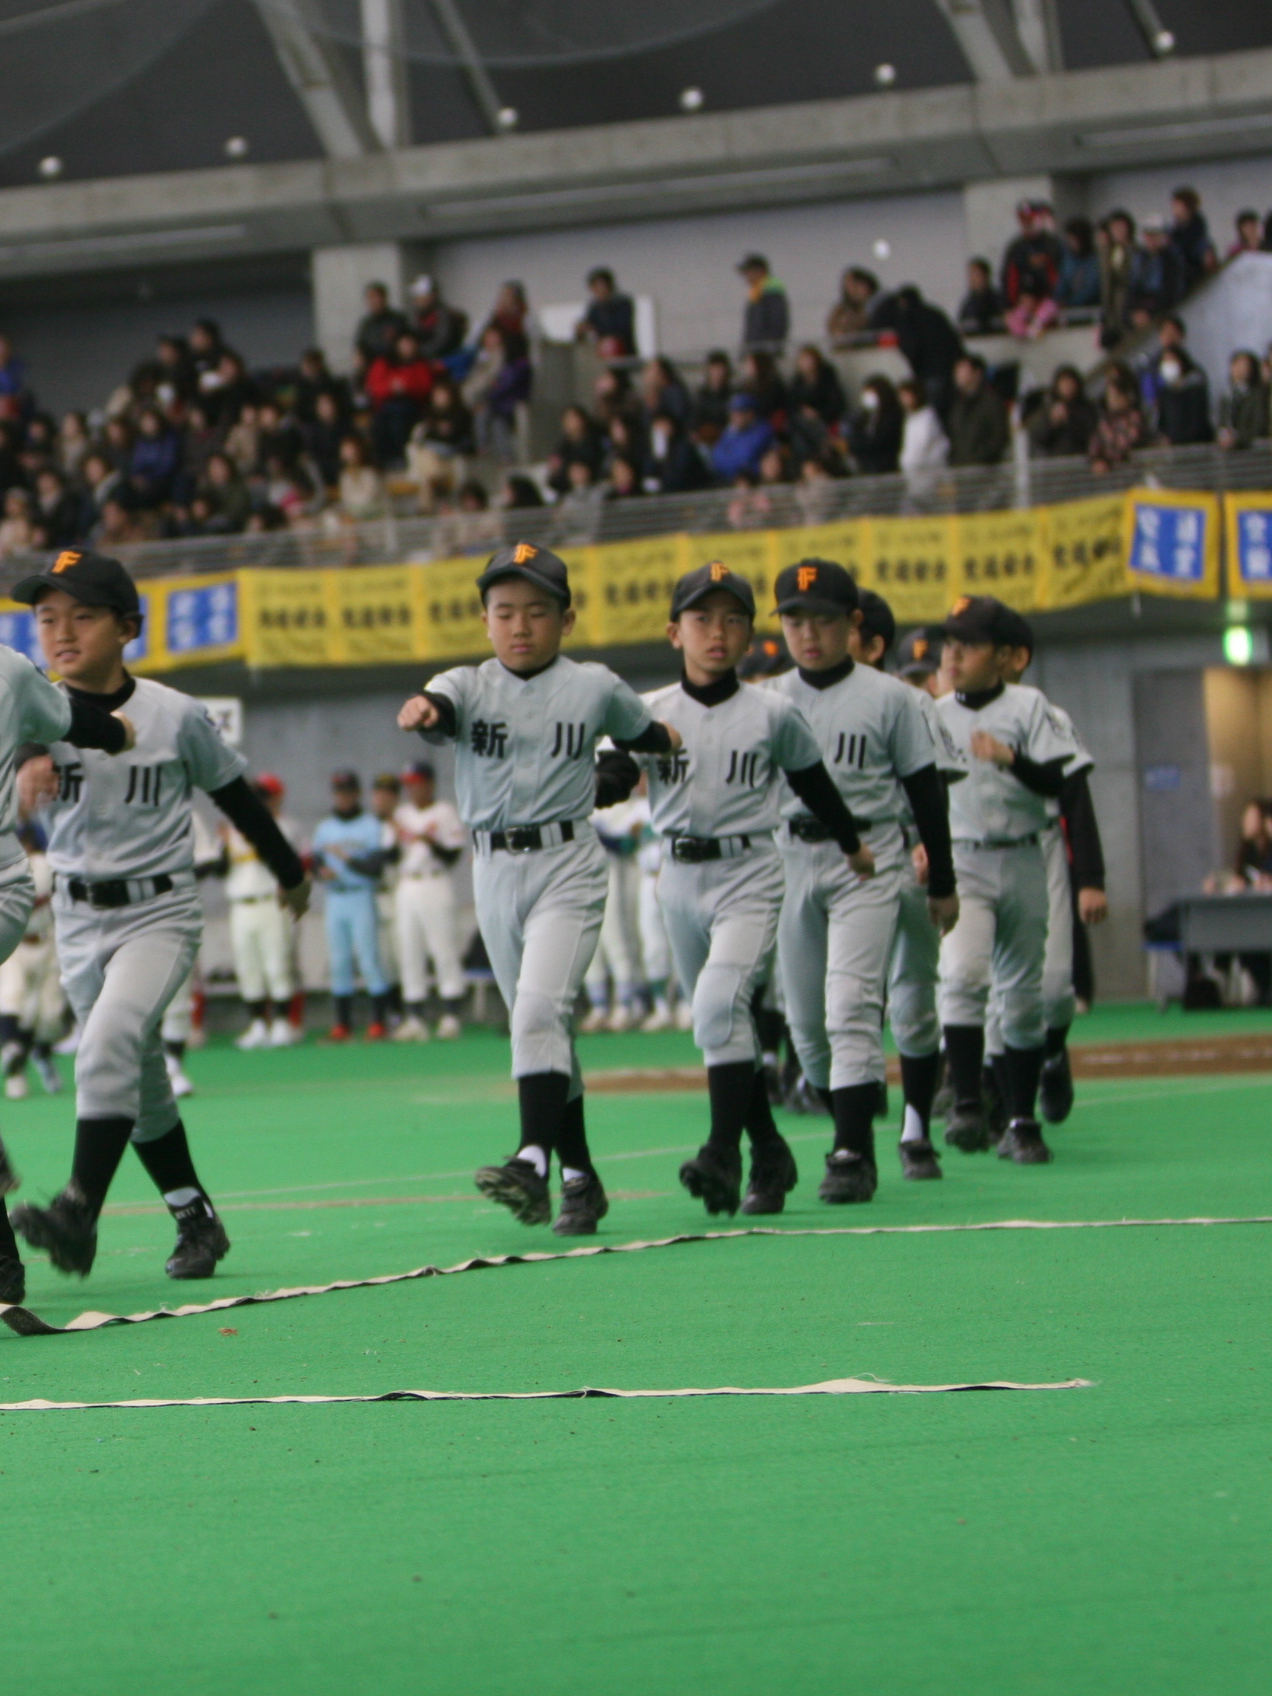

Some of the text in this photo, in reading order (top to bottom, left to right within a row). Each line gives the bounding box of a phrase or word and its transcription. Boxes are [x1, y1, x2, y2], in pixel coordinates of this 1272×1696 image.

[52, 550, 82, 574] F
[513, 543, 539, 564] F
[797, 566, 818, 591] F
[471, 718, 507, 758] 新
